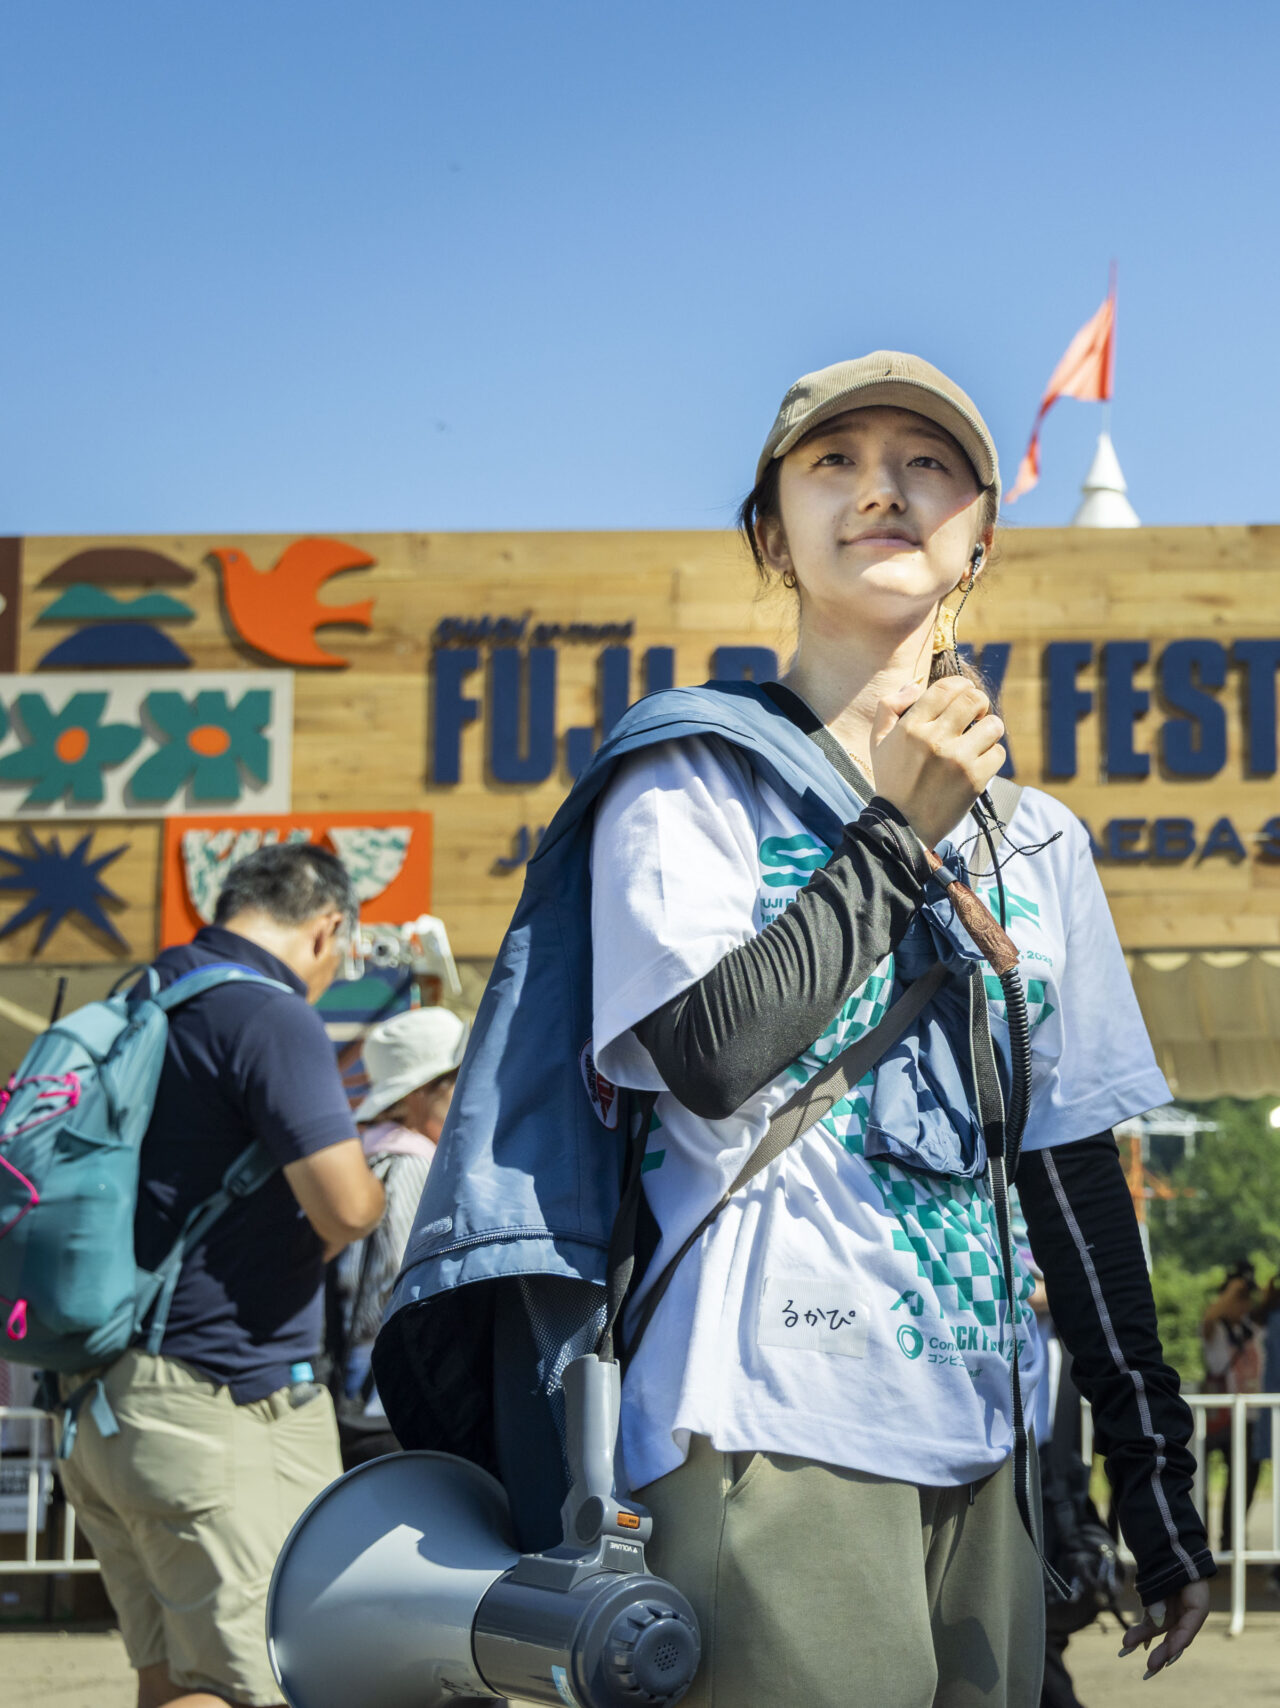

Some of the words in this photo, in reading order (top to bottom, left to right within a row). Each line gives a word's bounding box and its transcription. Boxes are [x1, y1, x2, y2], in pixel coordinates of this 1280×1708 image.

[781, 1299, 857, 1330] るかぴ
[610, 1543, 634, 1552] VOLUME
